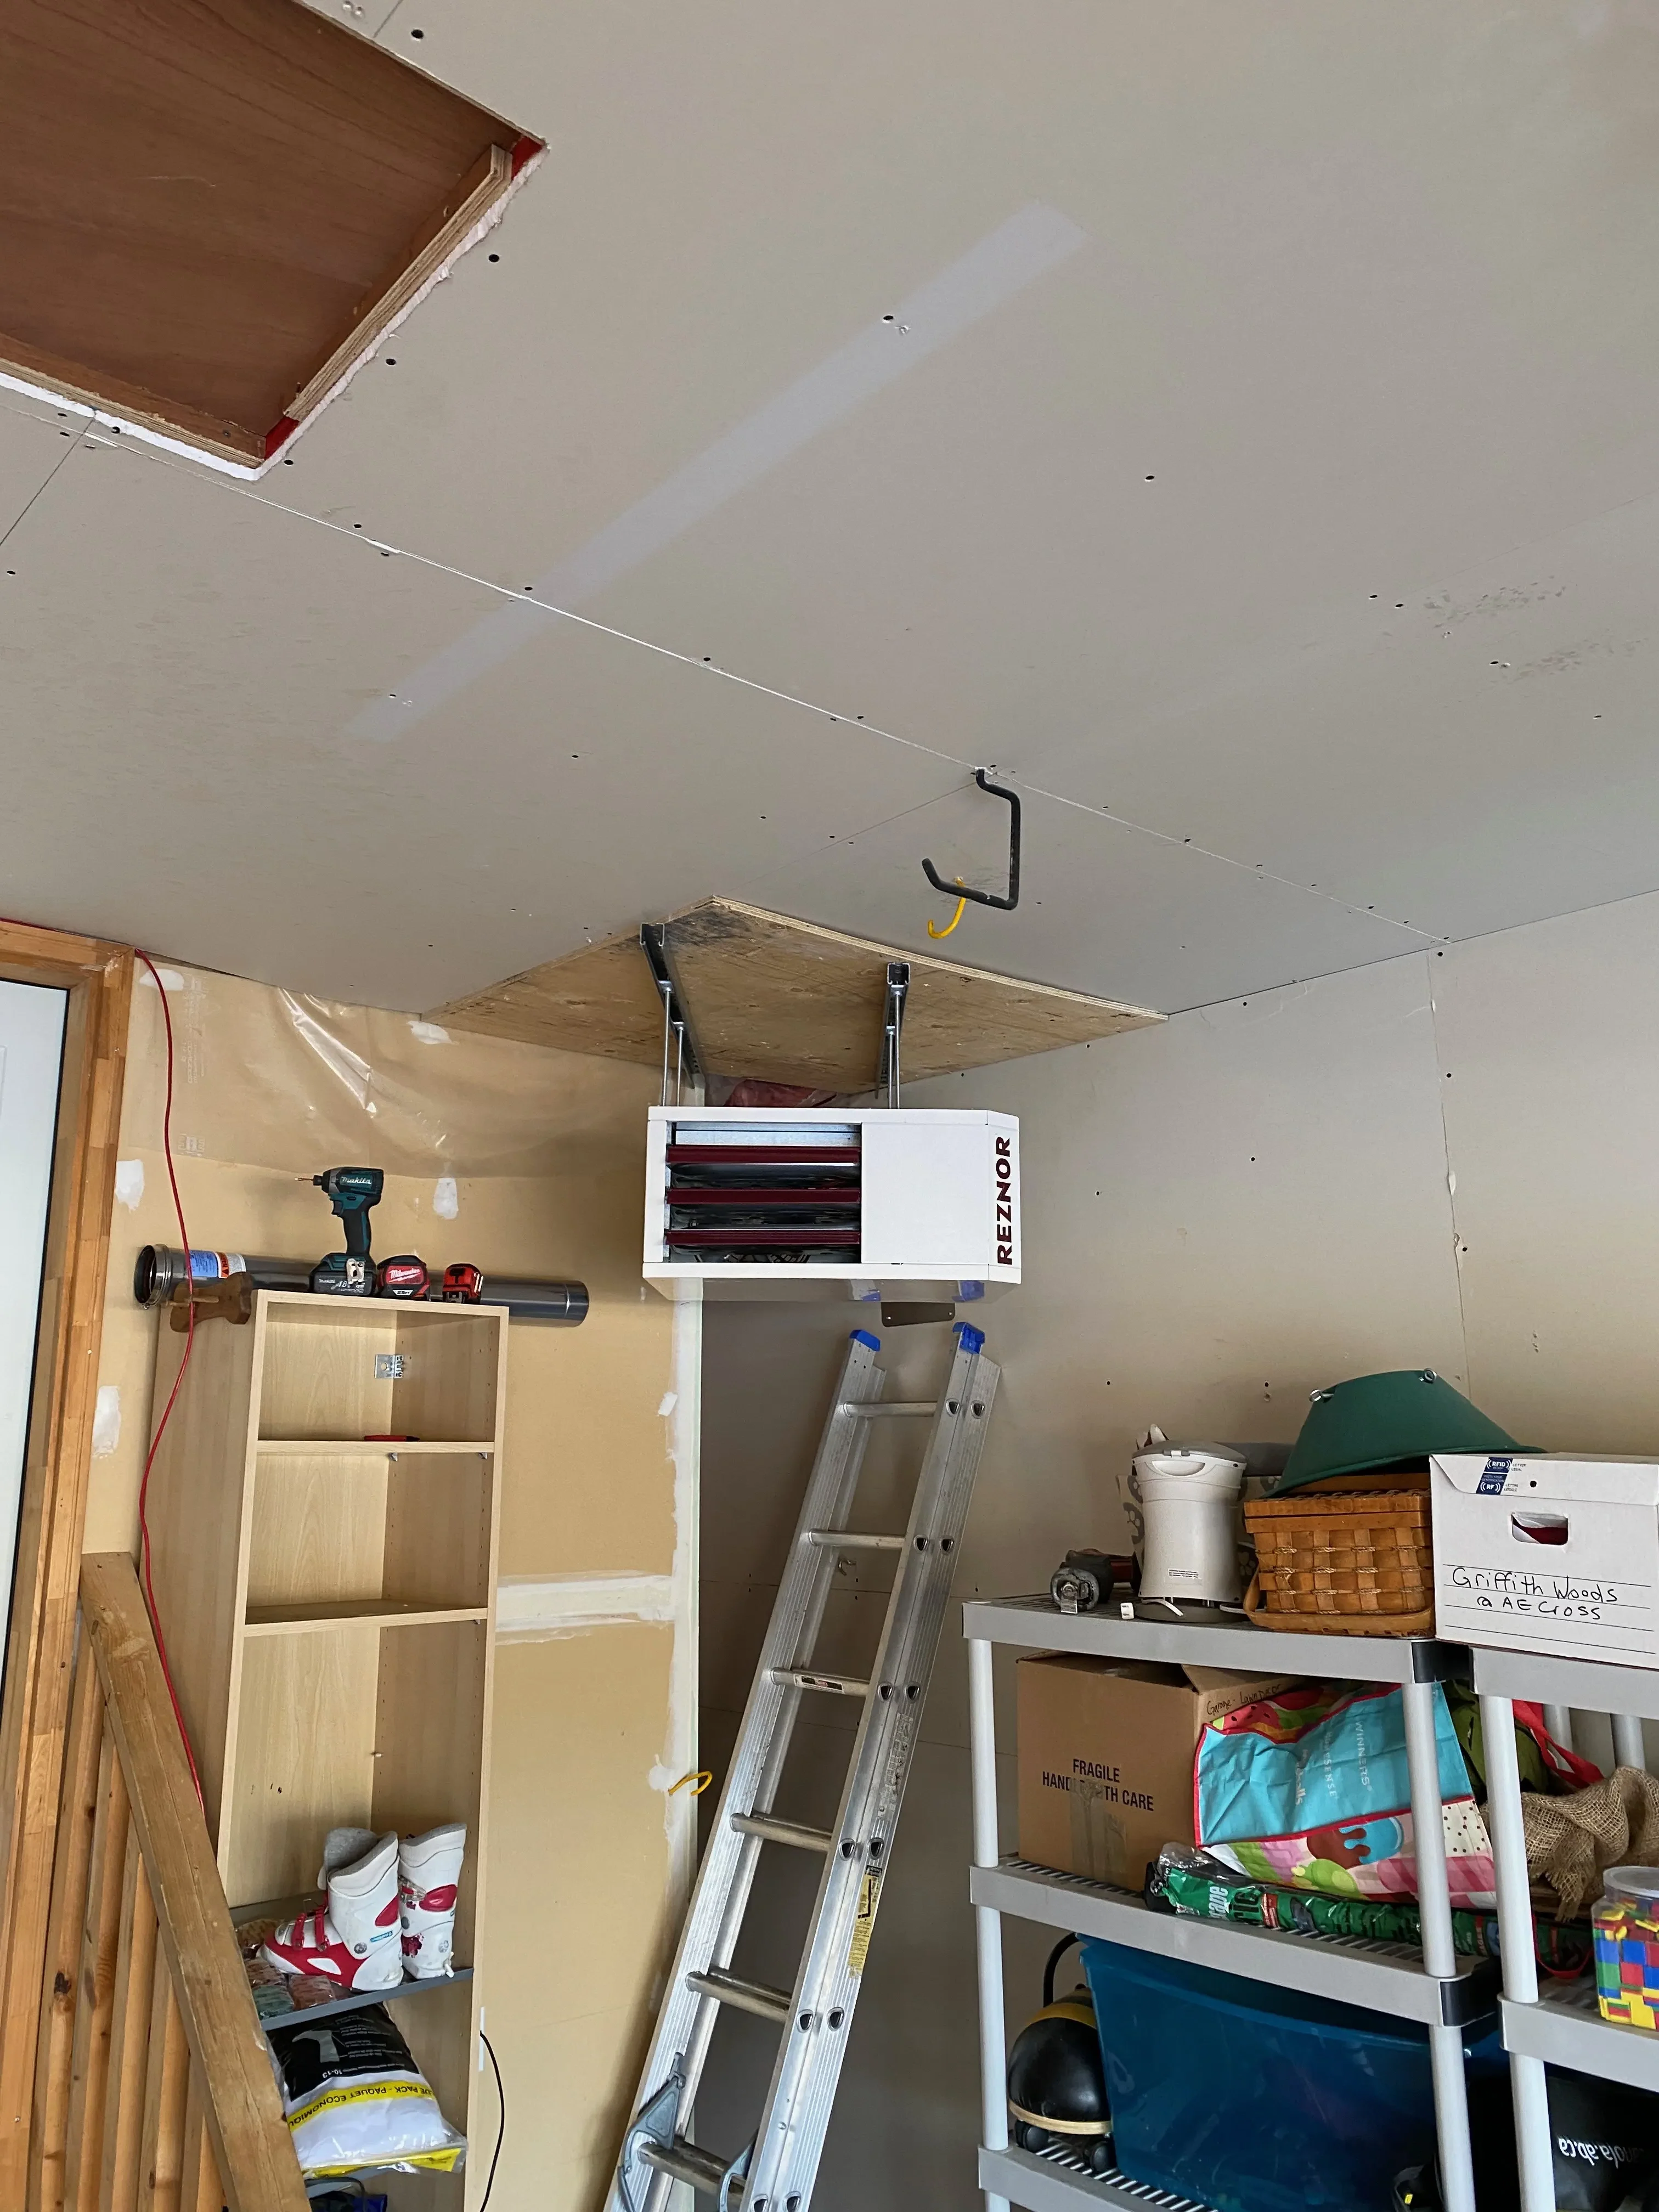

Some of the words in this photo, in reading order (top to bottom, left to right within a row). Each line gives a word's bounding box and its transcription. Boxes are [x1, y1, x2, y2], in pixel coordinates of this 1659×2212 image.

[996, 1136, 1013, 1265] REZNOR
[388, 1268, 420, 1279] Milwaukee
[1453, 1567, 1544, 1595] Griffith
[1553, 1575, 1618, 1604] Woods
[1356, 1720, 1370, 1786] WINNERS
[1073, 1758, 1120, 1783] FRAGILE
[1122, 1790, 1154, 1812] CARE
[322, 2069, 342, 2078] 10-13
[350, 2086, 387, 2098] PAQUET
